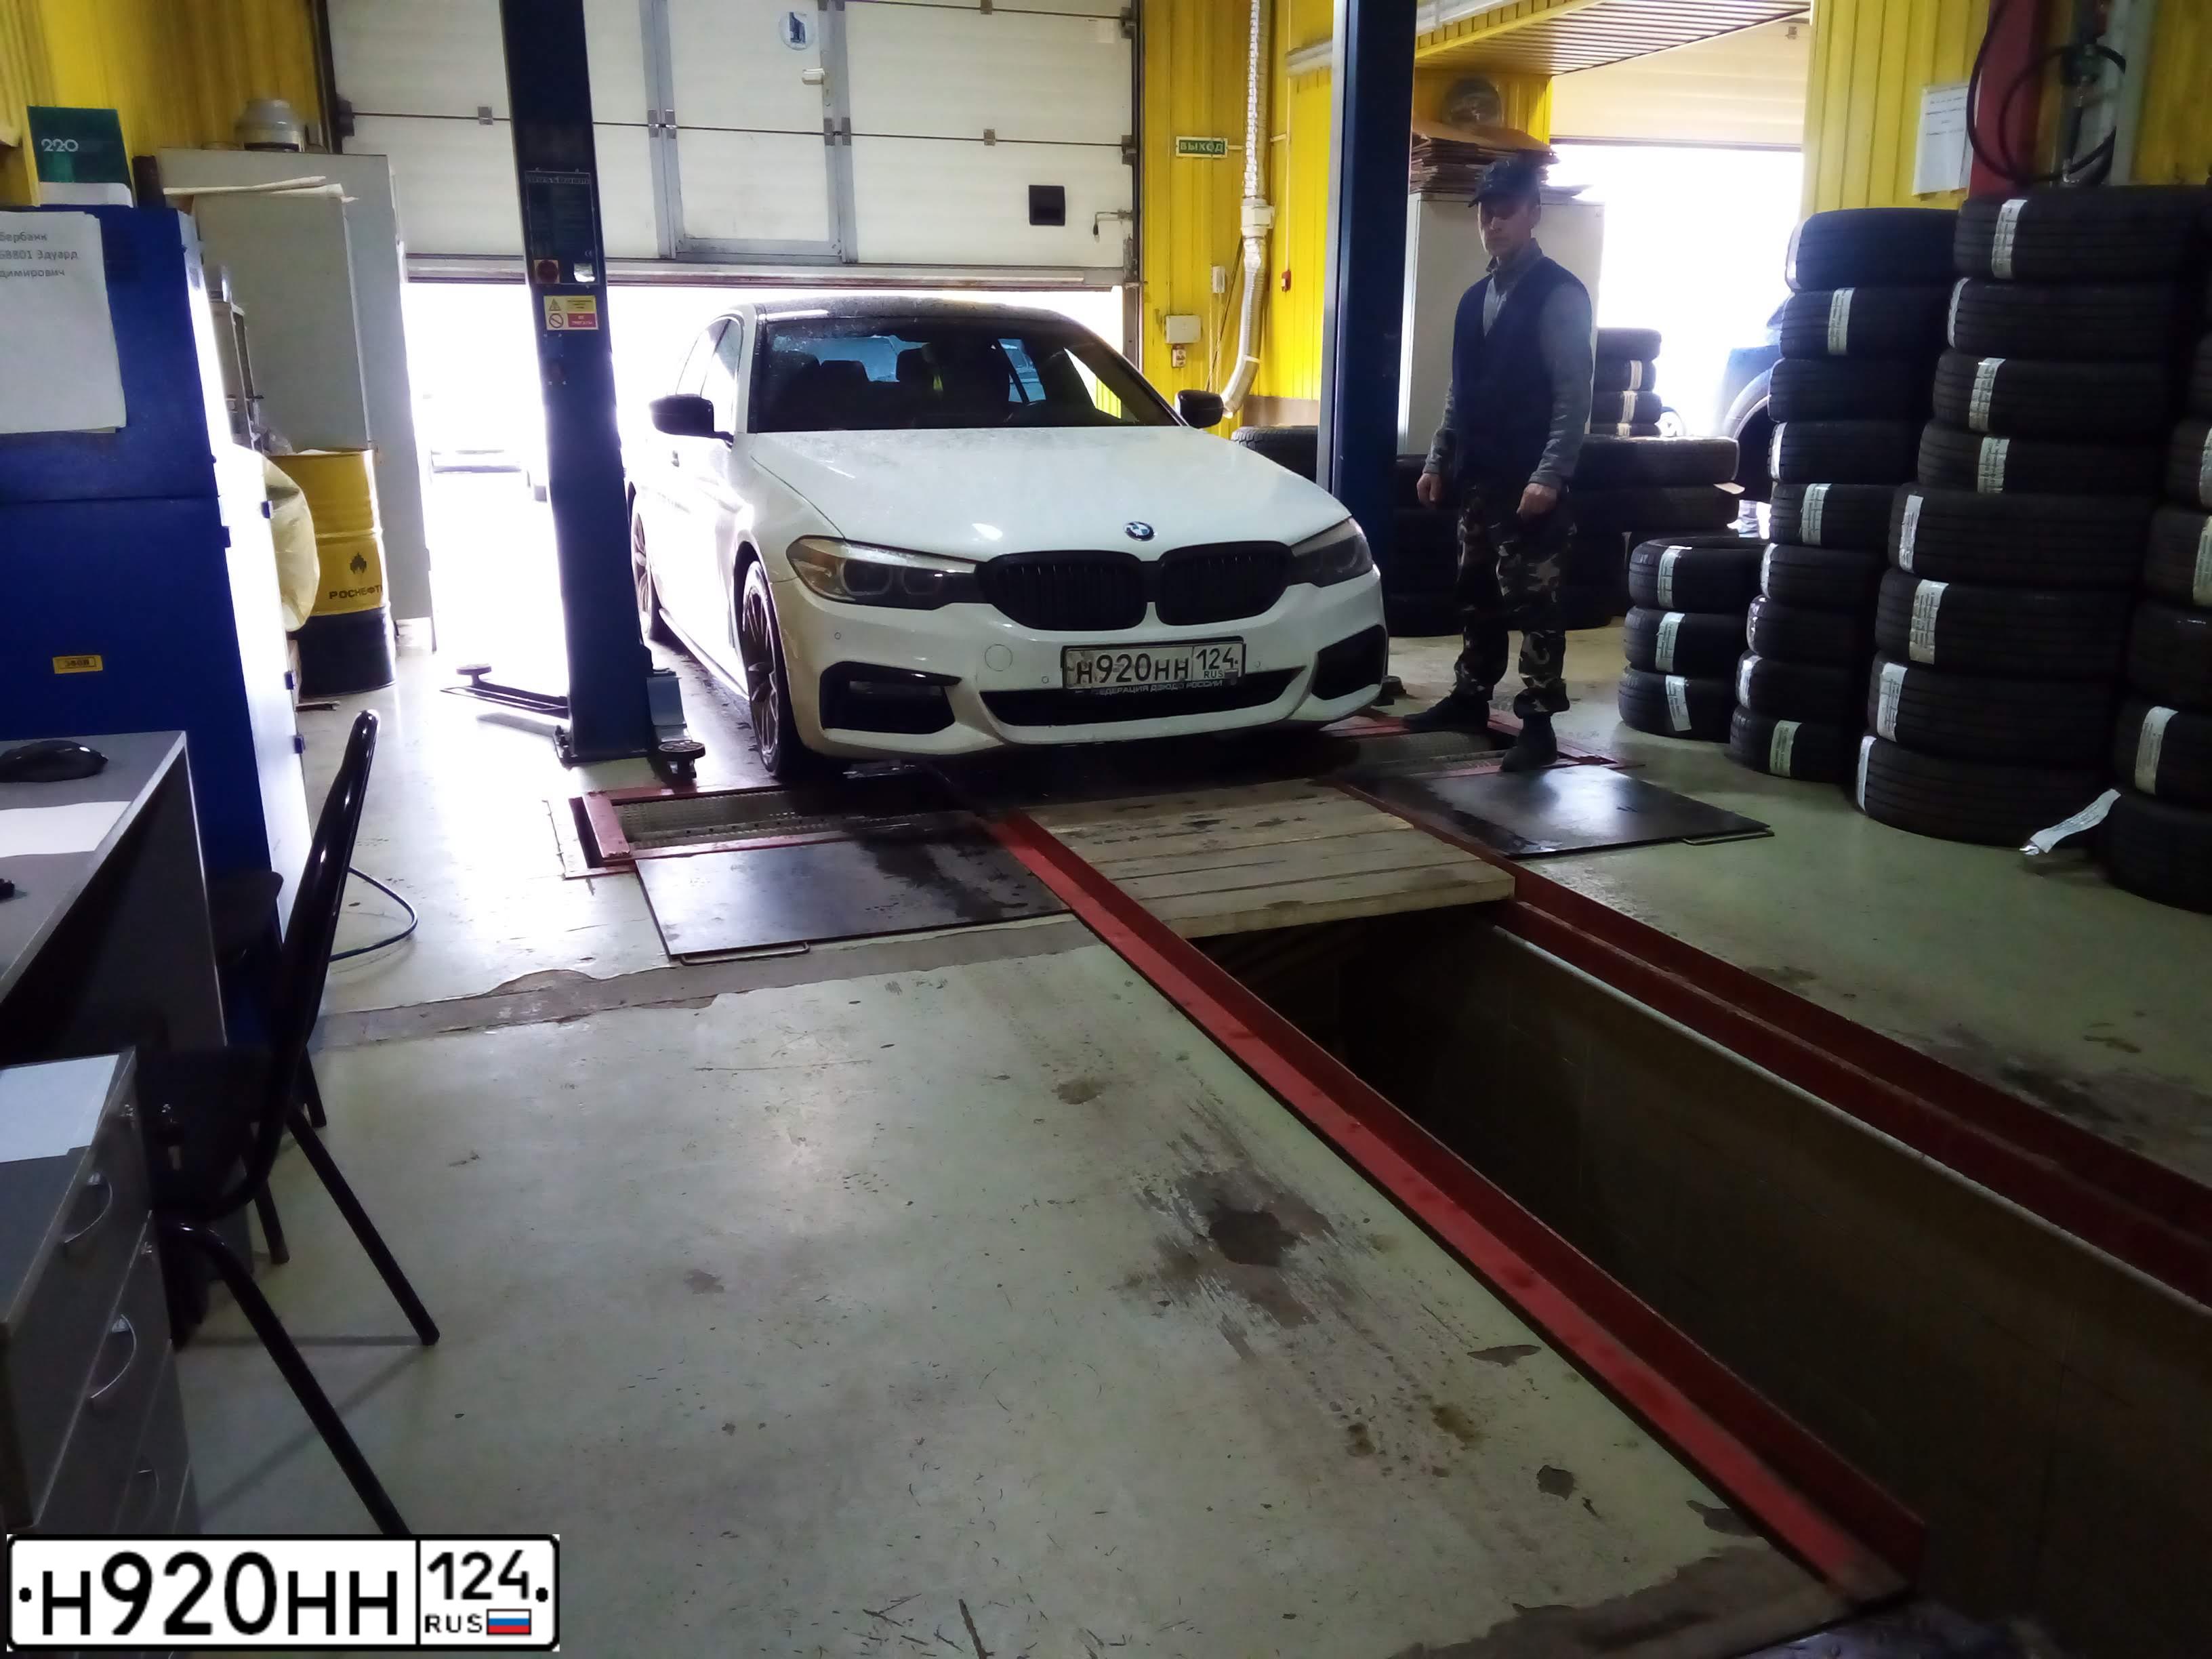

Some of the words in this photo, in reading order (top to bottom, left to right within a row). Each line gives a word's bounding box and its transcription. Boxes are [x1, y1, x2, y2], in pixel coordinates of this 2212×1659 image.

[41, 138, 79, 152] 220
[1180, 141, 1224, 153] ВЫХОД
[1076, 653, 1189, 684] Н920НН
[1195, 647, 1234, 671] 124
[1204, 670, 1224, 678] RUS
